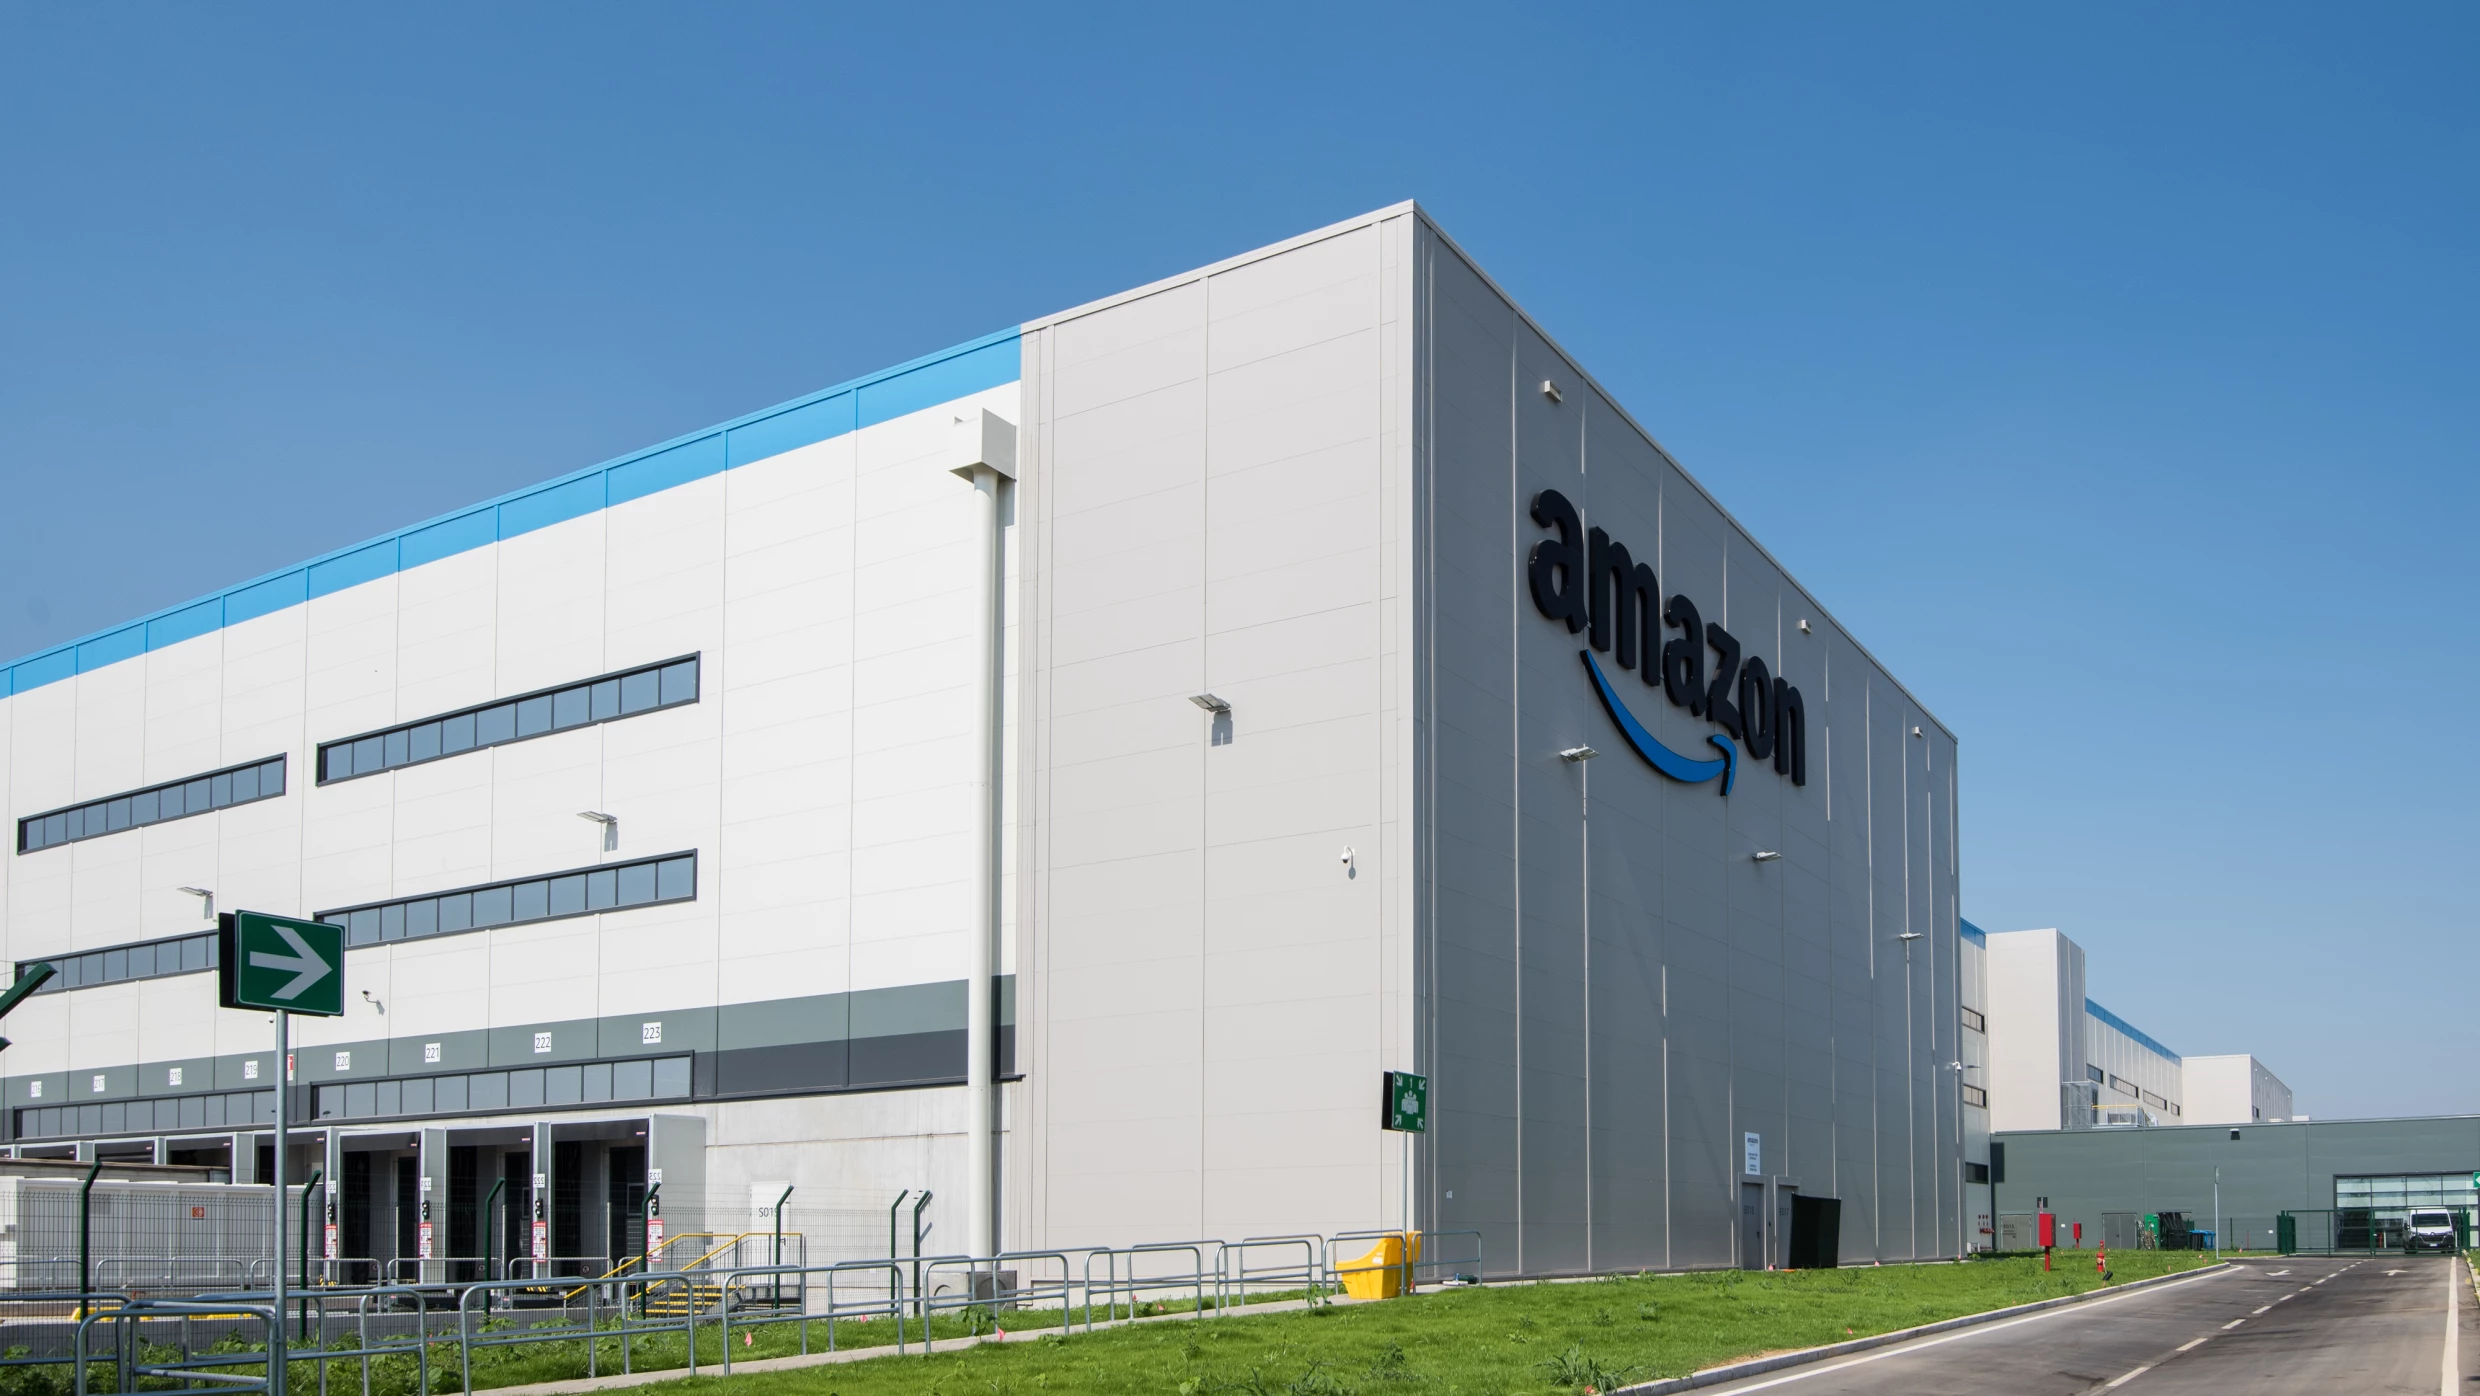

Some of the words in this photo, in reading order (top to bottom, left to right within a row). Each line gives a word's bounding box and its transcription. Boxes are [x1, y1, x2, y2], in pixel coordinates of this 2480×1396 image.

[1528, 489, 1805, 786] amazon
[644, 1027, 660, 1039] 223
[536, 1037, 551, 1049] 222
[426, 1047, 439, 1059] 221
[337, 1056, 349, 1067] 220
[246, 1065, 257, 1075] 219
[170, 1072, 181, 1082] 218
[1409, 1077, 1413, 1088] 1
[32, 1084, 41, 1093] 216
[94, 1078, 105, 1088] 217
